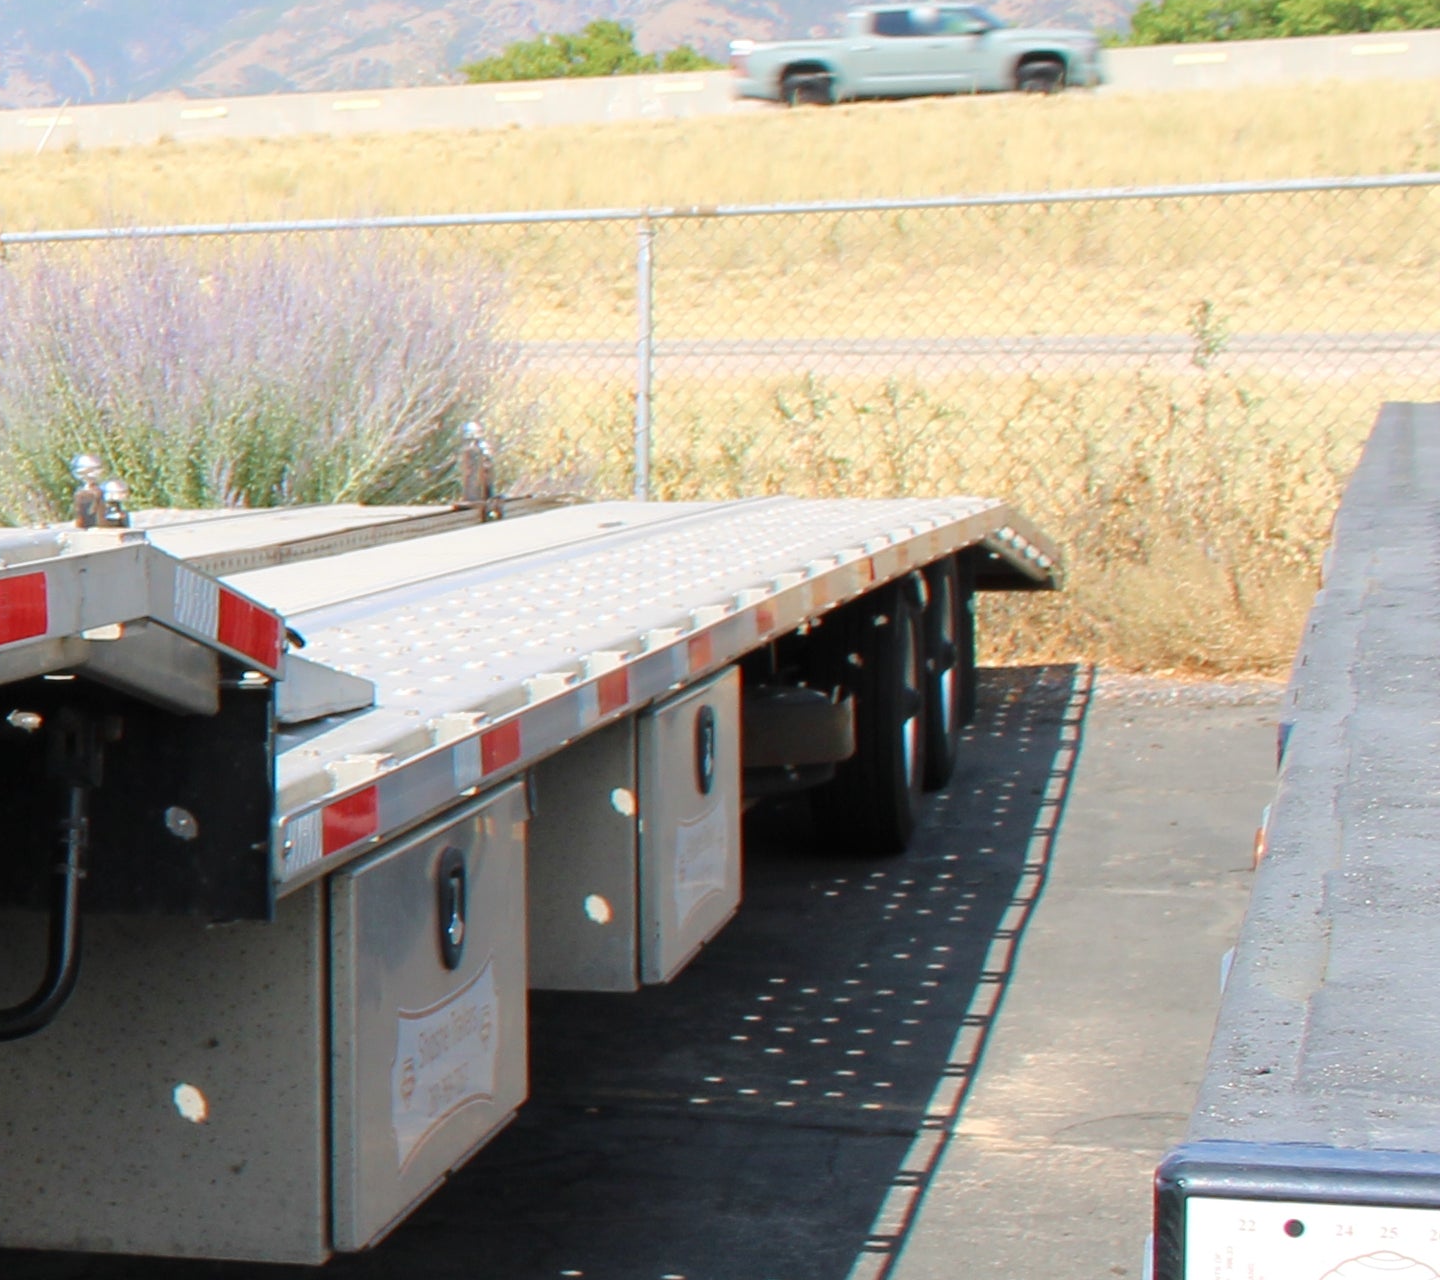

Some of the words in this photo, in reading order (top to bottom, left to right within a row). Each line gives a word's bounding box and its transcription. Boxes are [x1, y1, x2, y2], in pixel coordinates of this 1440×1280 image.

[1238, 1219, 1257, 1234] 22
[1335, 1223, 1354, 1237] 24
[1380, 1226, 1399, 1239] 25
[1429, 1228, 1440, 1241] 2
[1247, 1263, 1255, 1280] AND
